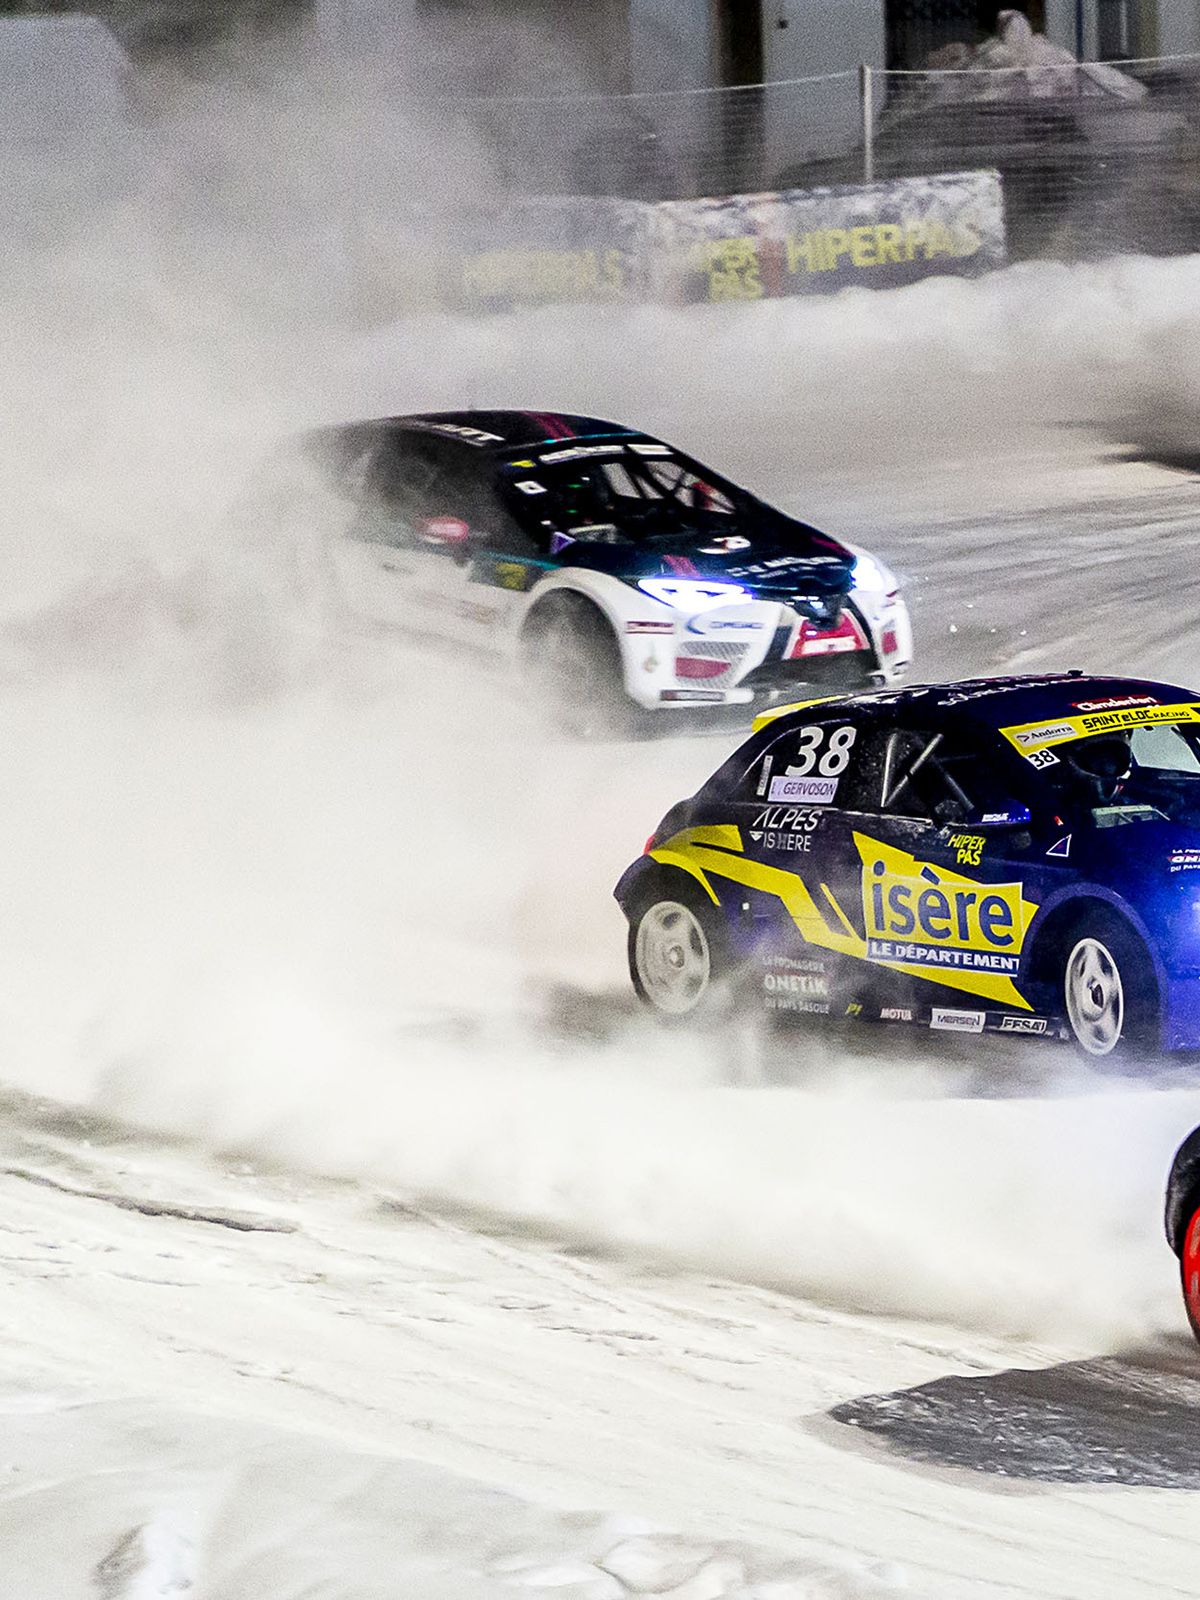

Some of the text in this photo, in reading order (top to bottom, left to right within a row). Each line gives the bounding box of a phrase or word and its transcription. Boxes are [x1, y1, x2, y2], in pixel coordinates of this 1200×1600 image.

[786, 221, 983, 274] HIPERPAS
[784, 726, 857, 777] 38
[1028, 750, 1055, 768] 38
[783, 781, 837, 796] GERVOSON
[752, 807, 824, 832] ALPES
[763, 832, 812, 852] IS HERE
[948, 834, 987, 851] HIPER
[956, 849, 982, 866] PAS
[872, 860, 1014, 946] isère
[871, 941, 1020, 971] LE DÉPARTEMENT
[763, 973, 828, 997] ONETIK
[881, 1008, 913, 1021] MOTUL
